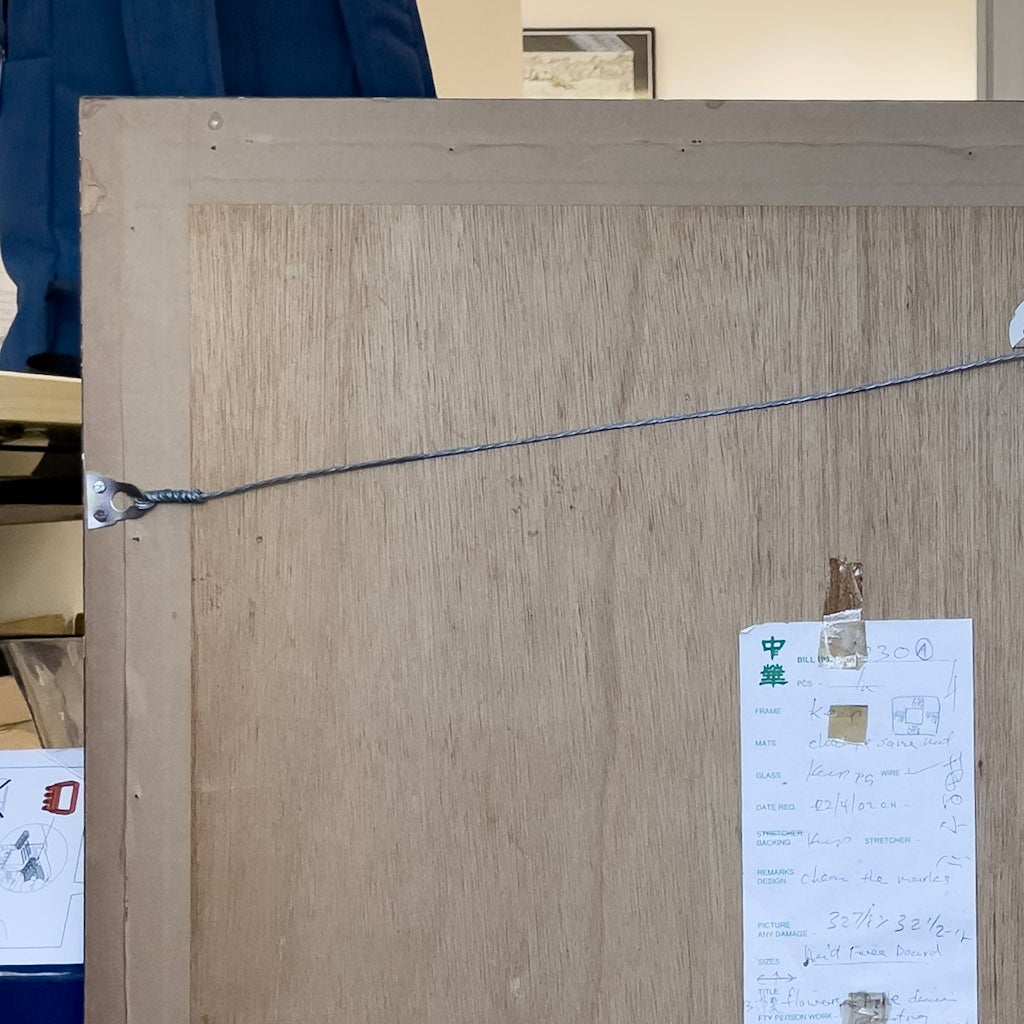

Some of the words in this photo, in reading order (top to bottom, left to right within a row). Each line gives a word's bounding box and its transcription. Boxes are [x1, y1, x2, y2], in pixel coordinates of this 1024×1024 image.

[759, 635, 788, 688] 中華
[755, 707, 782, 715] FRAME
[756, 771, 781, 779] GLASS
[756, 803, 775, 811] DATE
[864, 836, 911, 844] STRETCHER
[758, 921, 791, 929] PICTURE
[758, 930, 773, 938] ANY
[775, 930, 808, 938] DAMAGE
[758, 988, 779, 996] TITLE
